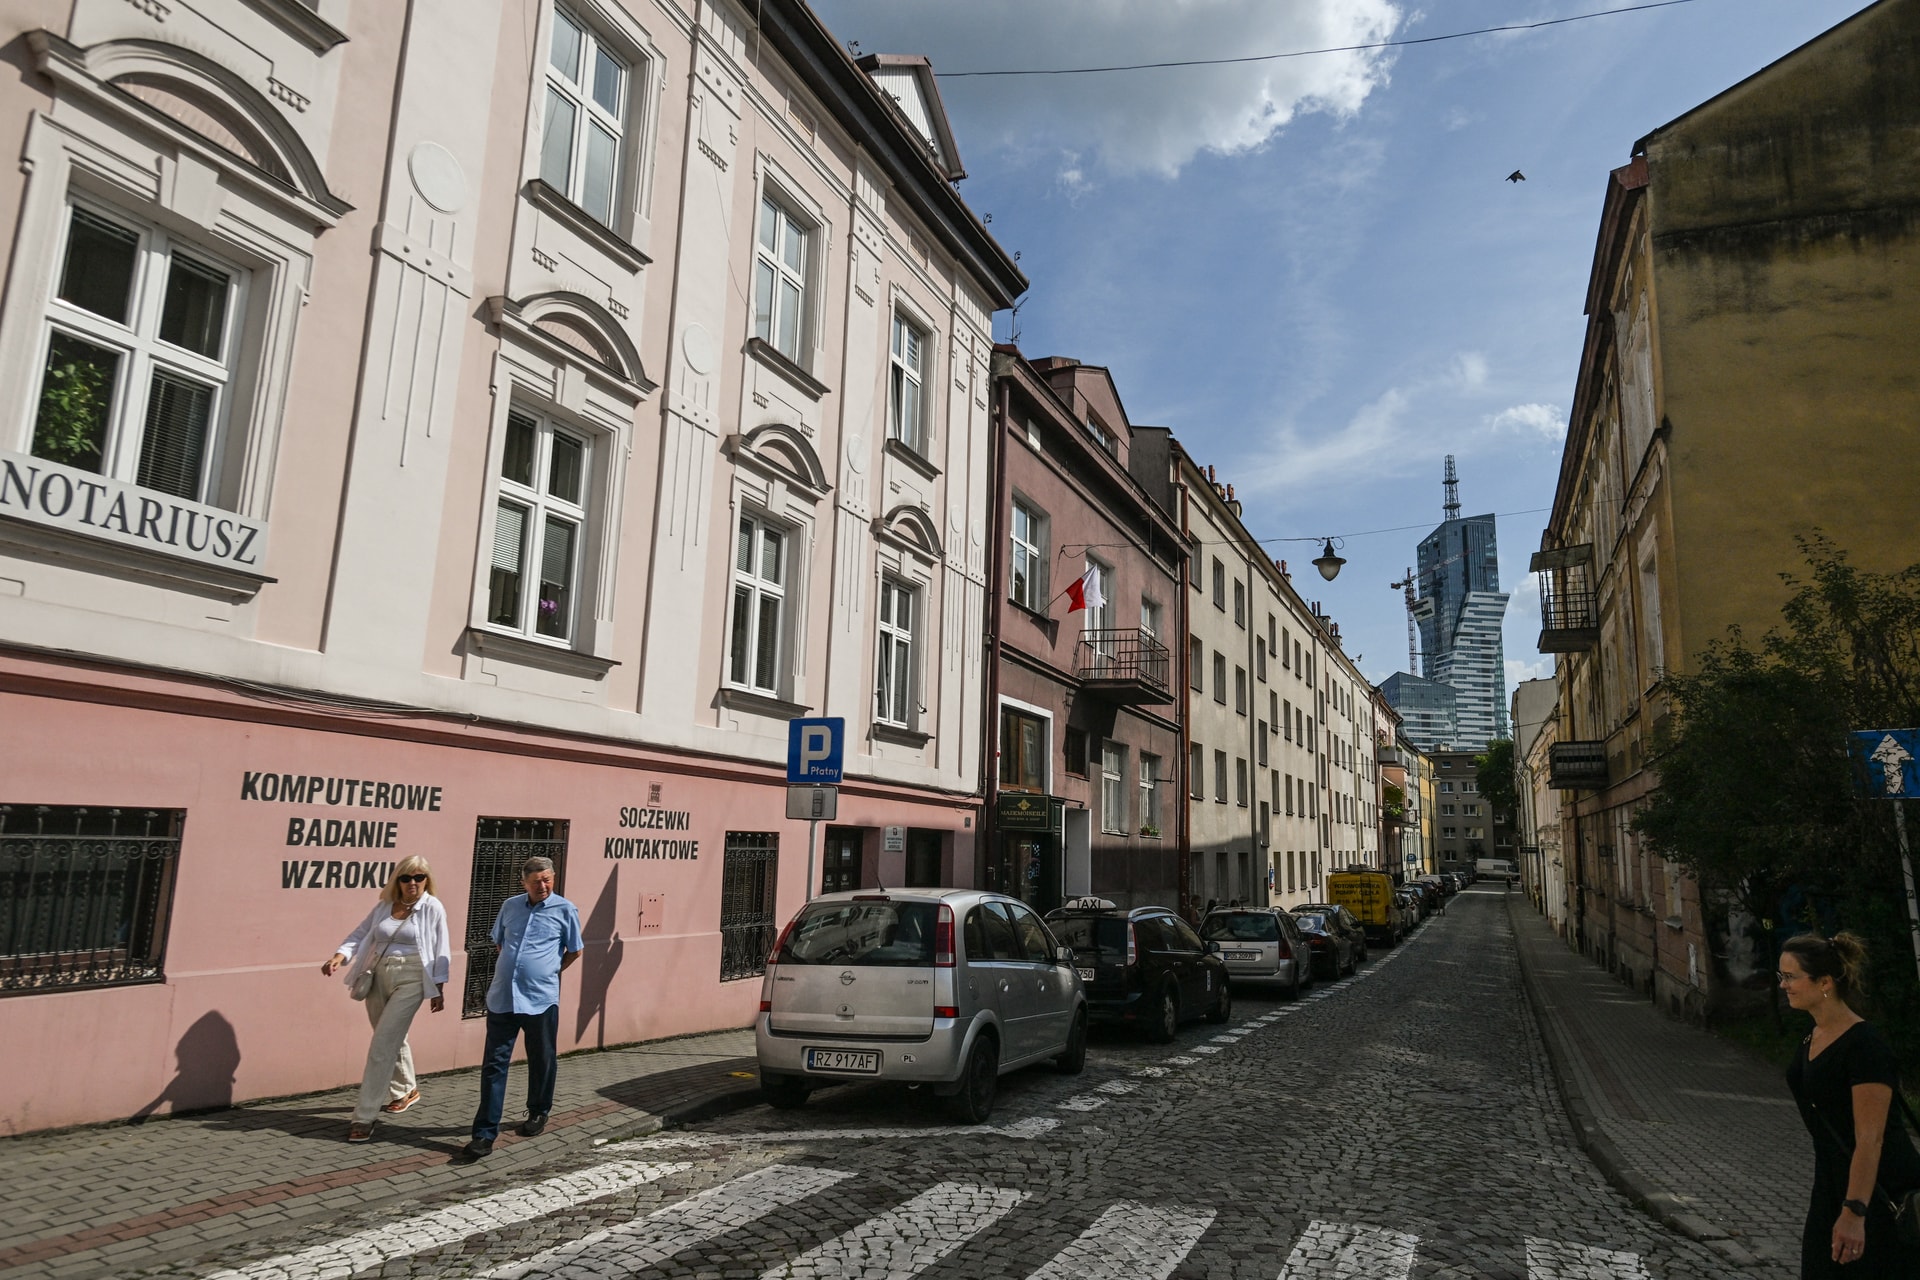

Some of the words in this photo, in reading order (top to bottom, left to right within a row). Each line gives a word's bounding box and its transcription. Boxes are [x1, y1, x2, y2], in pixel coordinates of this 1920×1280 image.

[0, 459, 259, 565] NOTARIUSZ
[800, 725, 832, 775] P
[810, 766, 839, 778] Płatny
[241, 771, 442, 811] KOMPUTEROWE
[619, 807, 690, 830] SOCZEWKI
[286, 818, 398, 848] BADANIE
[604, 838, 699, 860] KONTAKTOWE
[282, 861, 395, 888] WZROKU
[1077, 899, 1101, 909] TAXI
[815, 1052, 832, 1067] RZ
[835, 1054, 874, 1069] 917AF
[903, 1055, 914, 1063] PL
